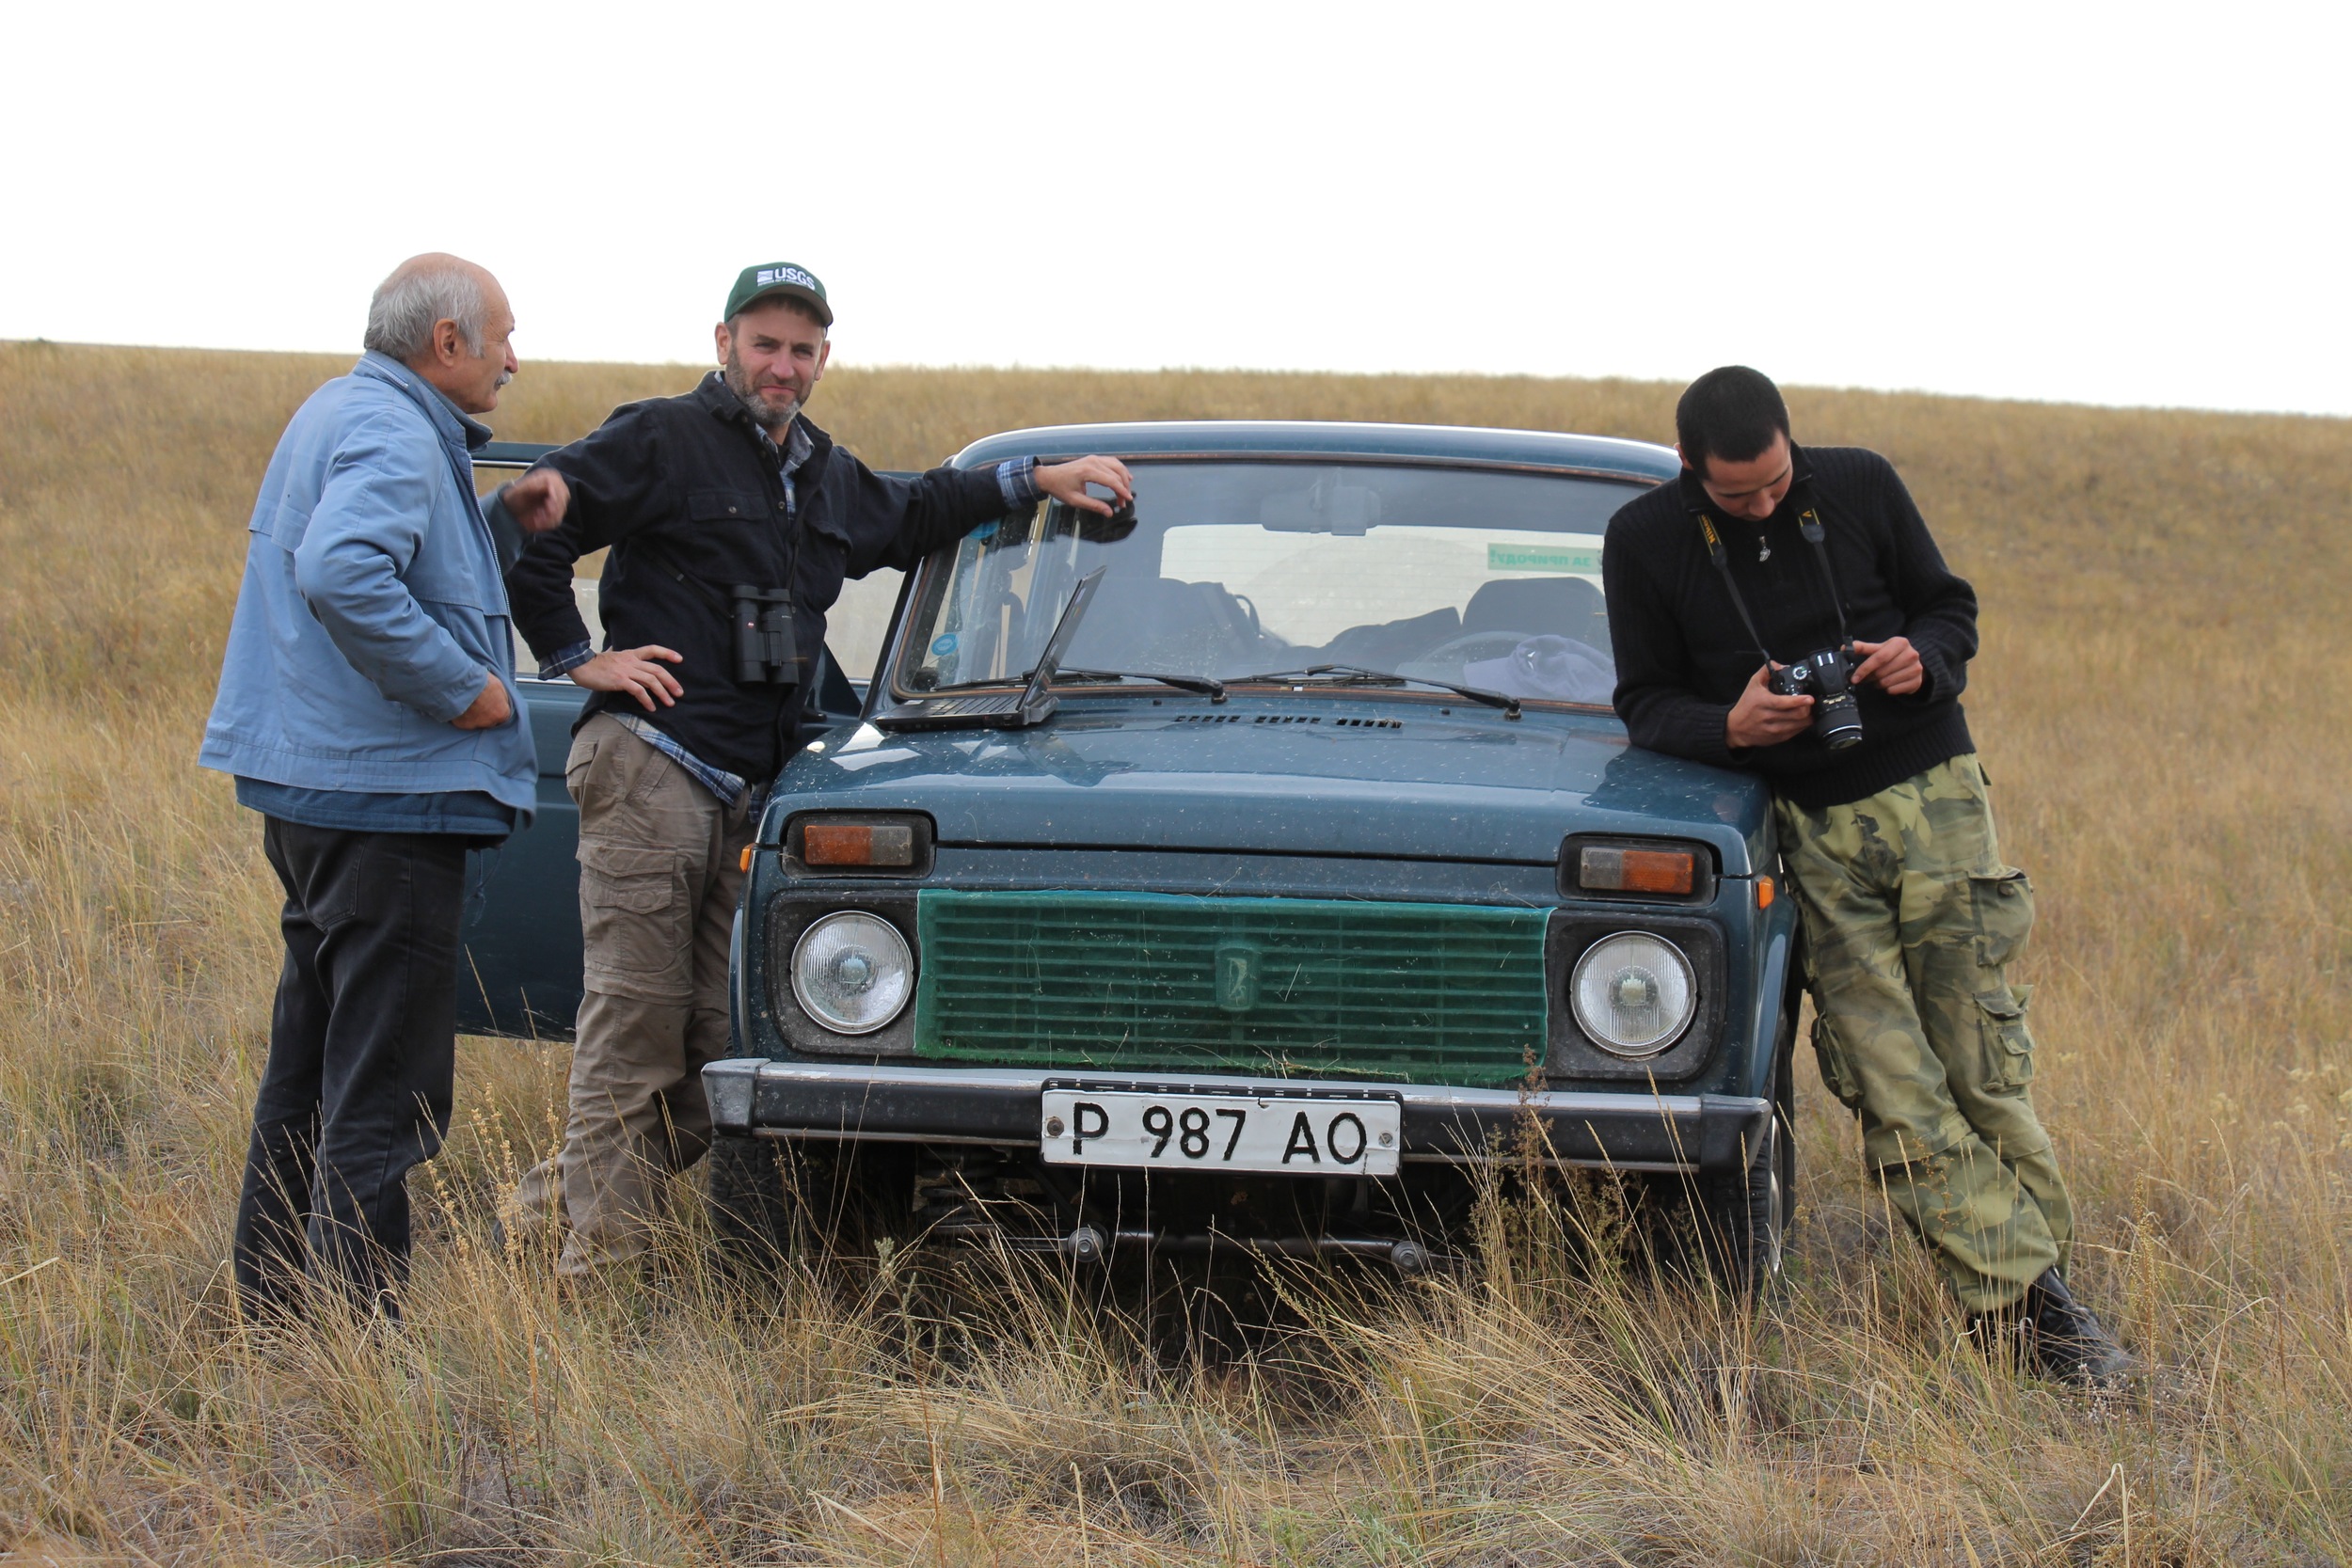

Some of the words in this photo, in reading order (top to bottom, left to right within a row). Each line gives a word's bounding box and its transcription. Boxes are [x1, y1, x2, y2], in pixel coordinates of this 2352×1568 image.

[774, 266, 816, 291] USGS
[1073, 1101, 1109, 1155] P
[1142, 1105, 1247, 1161] 987
[1282, 1111, 1367, 1164] AO
